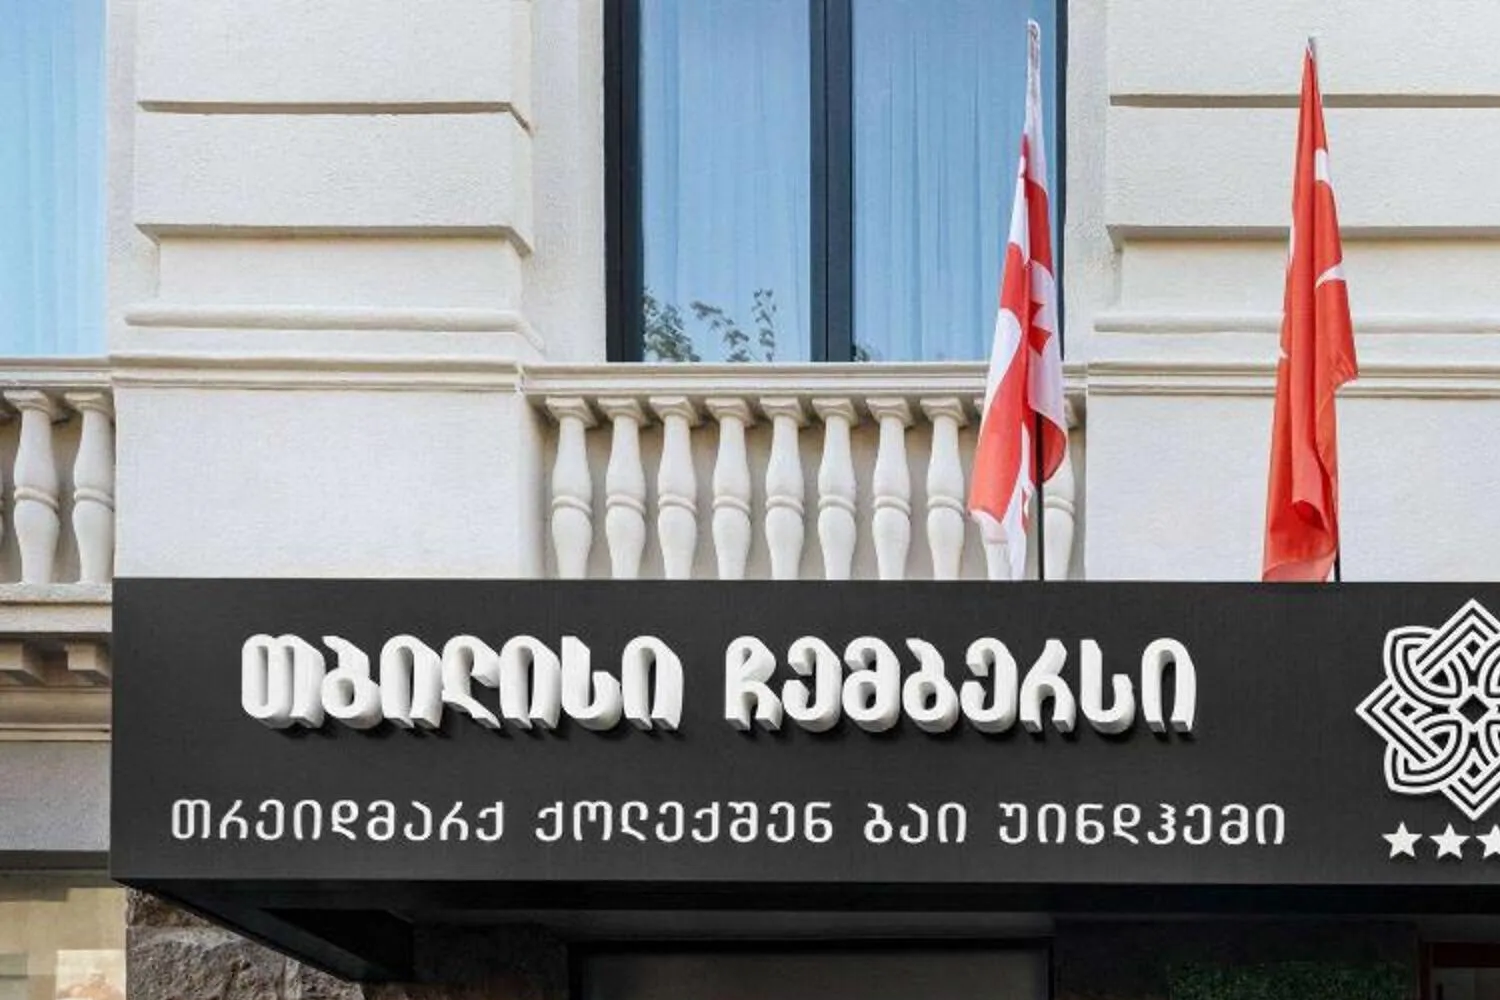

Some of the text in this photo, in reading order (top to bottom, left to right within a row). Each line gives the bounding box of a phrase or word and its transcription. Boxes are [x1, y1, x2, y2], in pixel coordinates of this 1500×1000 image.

[241, 634, 1197, 732] თბილისი ჩემბერსი
[171, 799, 1285, 846] თრეიდმარქ ქოლექშენ ბაი უინდჰემი
